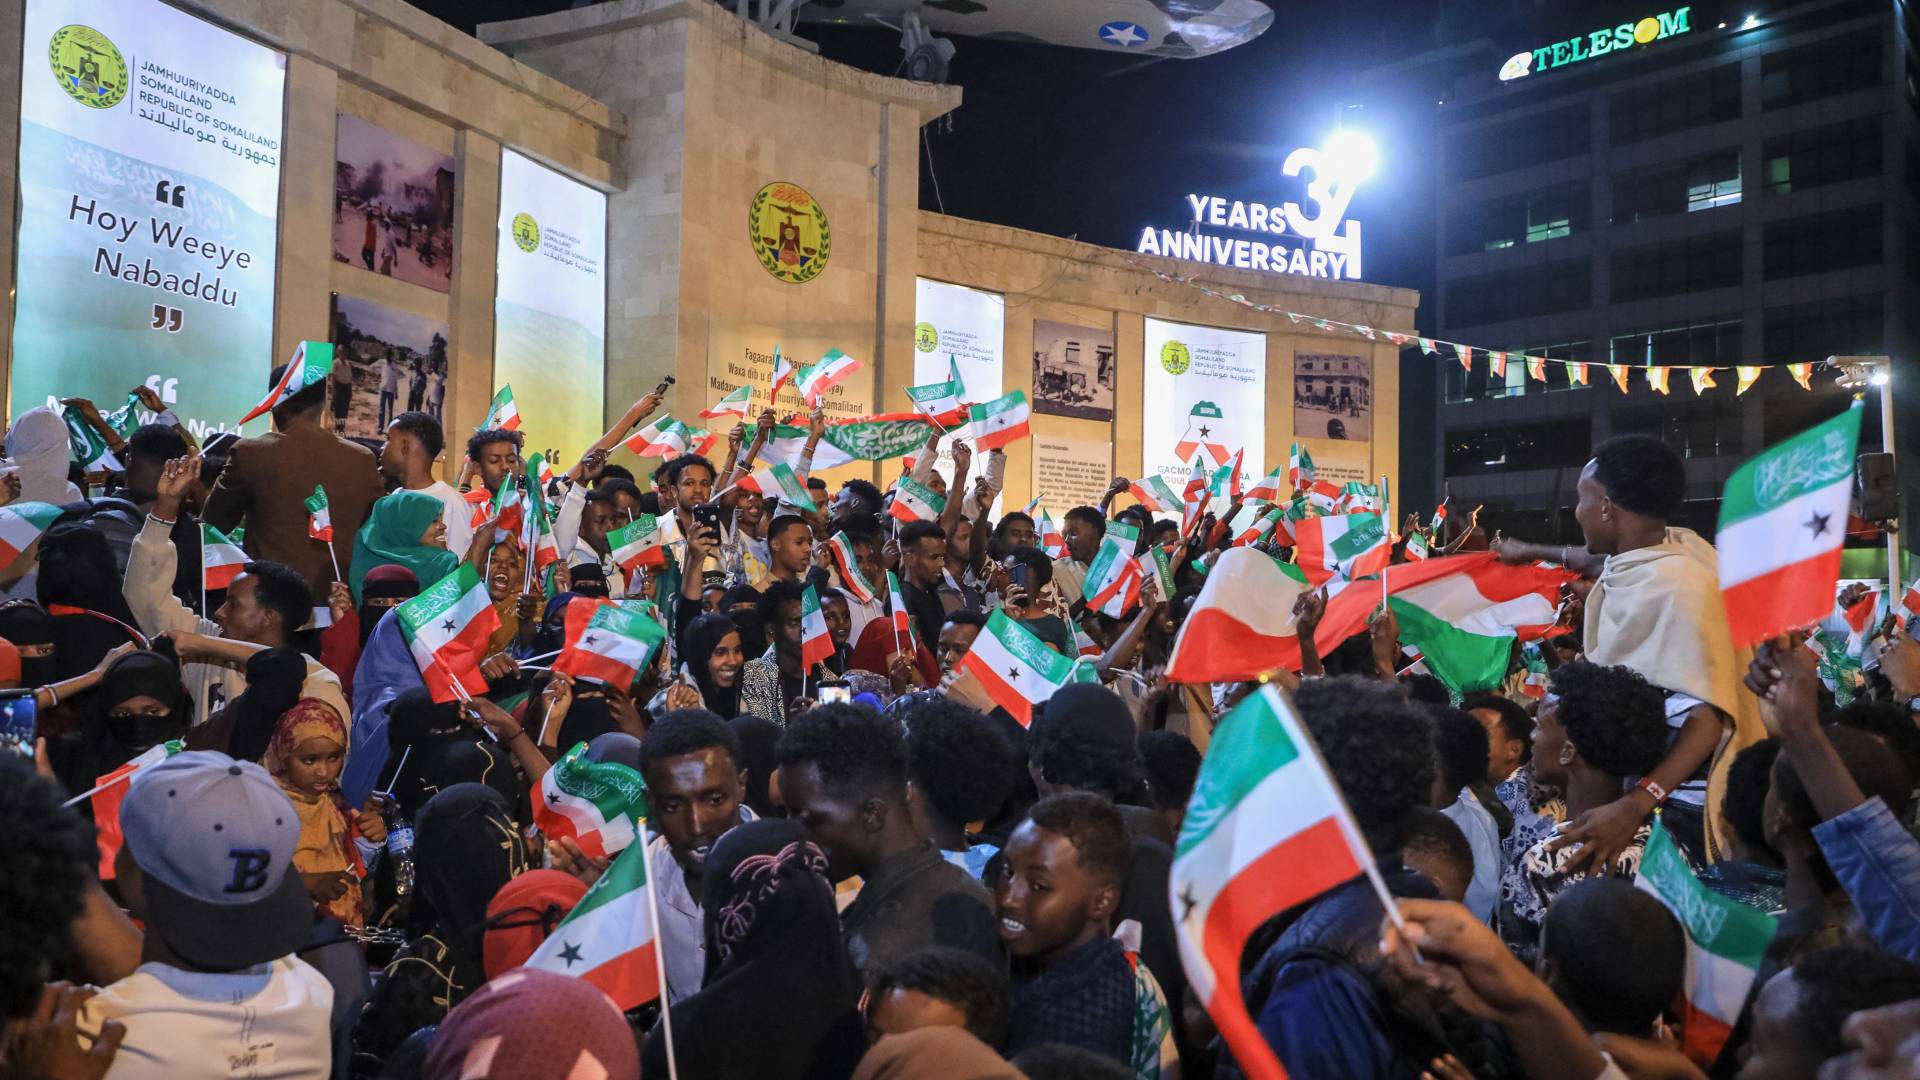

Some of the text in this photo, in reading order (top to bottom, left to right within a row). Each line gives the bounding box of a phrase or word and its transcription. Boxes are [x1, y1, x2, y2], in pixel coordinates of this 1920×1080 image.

[1533, 6, 1691, 72] TELESOM
[140, 75, 213, 111] SOMALILAND
[141, 61, 237, 106] JAMHUURIYADDA
[140, 91, 279, 150] REPUBLIC OF SOMALILAND
[69, 195, 251, 270] Hoy Weeye
[1189, 194, 1287, 234] YEARS
[1138, 227, 1348, 280] ANNIVERSARY
[94, 247, 238, 307] Nabaddu
[728, 362, 746, 377] Waxa
[821, 398, 863, 414] Somaliland
[224, 848, 272, 893] B
